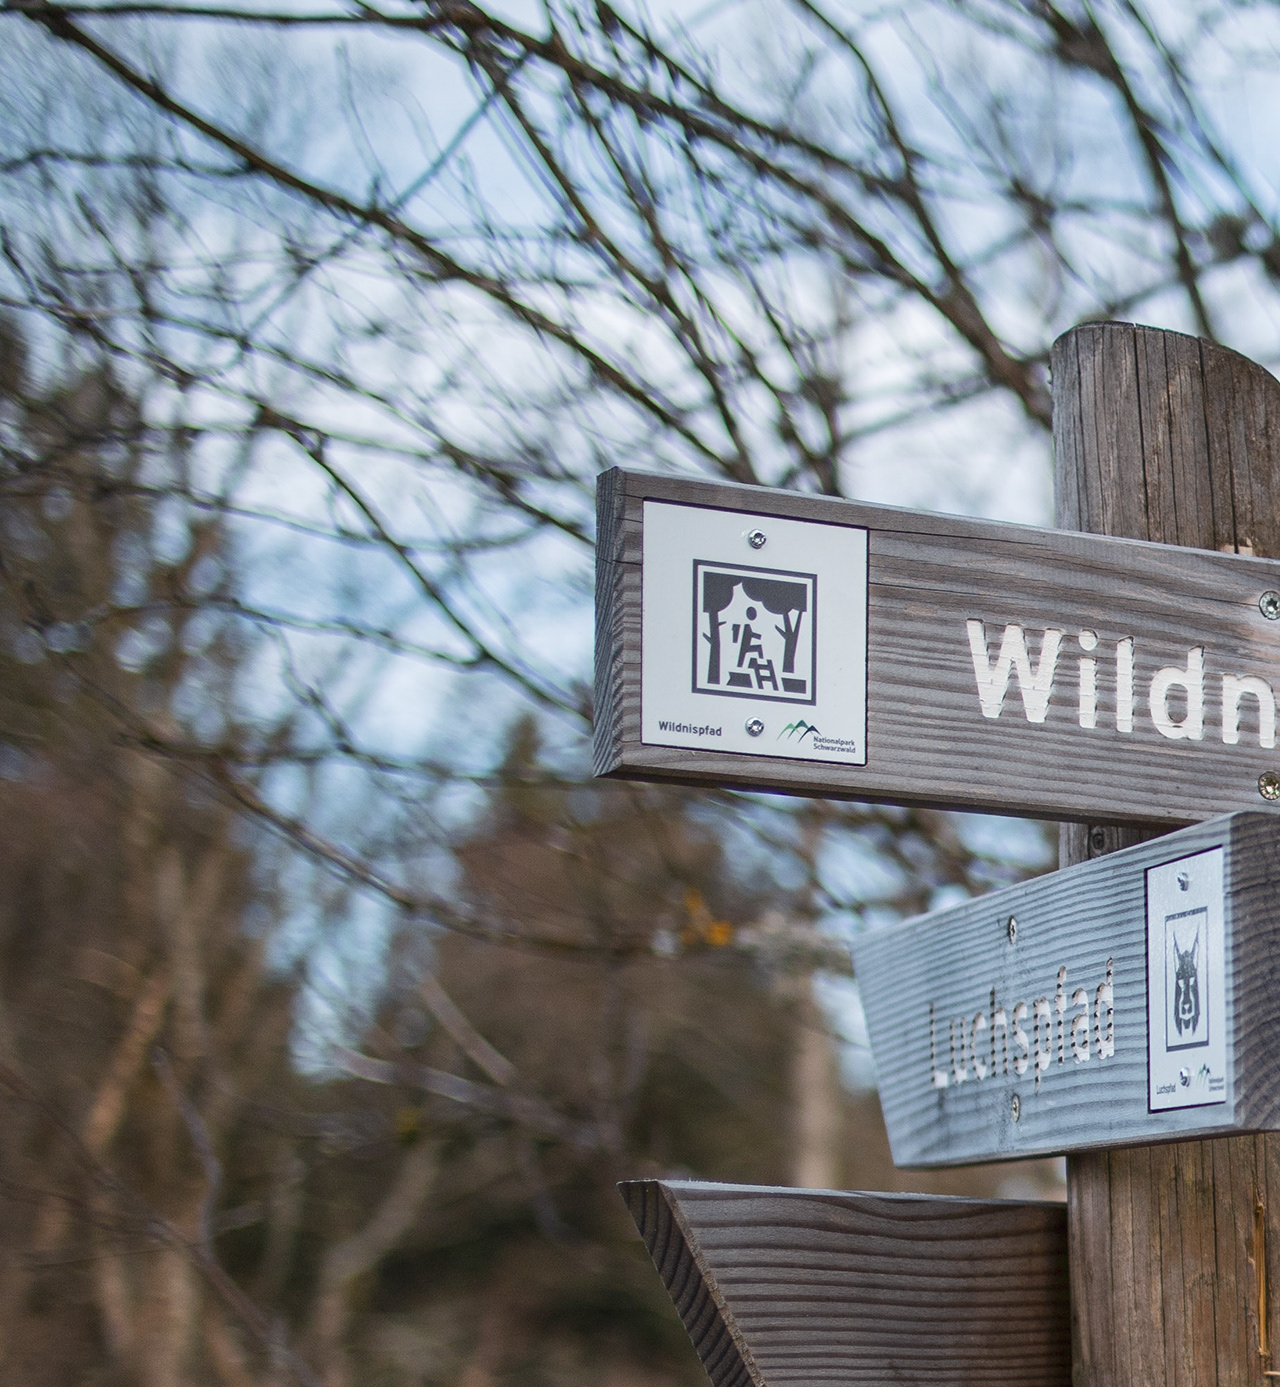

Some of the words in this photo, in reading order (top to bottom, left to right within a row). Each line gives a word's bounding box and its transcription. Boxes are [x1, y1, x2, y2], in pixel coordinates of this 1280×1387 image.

[658, 720, 722, 737] Wildnispfad
[813, 735, 855, 747] Nationalpark
[813, 743, 856, 754] Schwarzwald
[929, 957, 1114, 1095] Luchspfad
